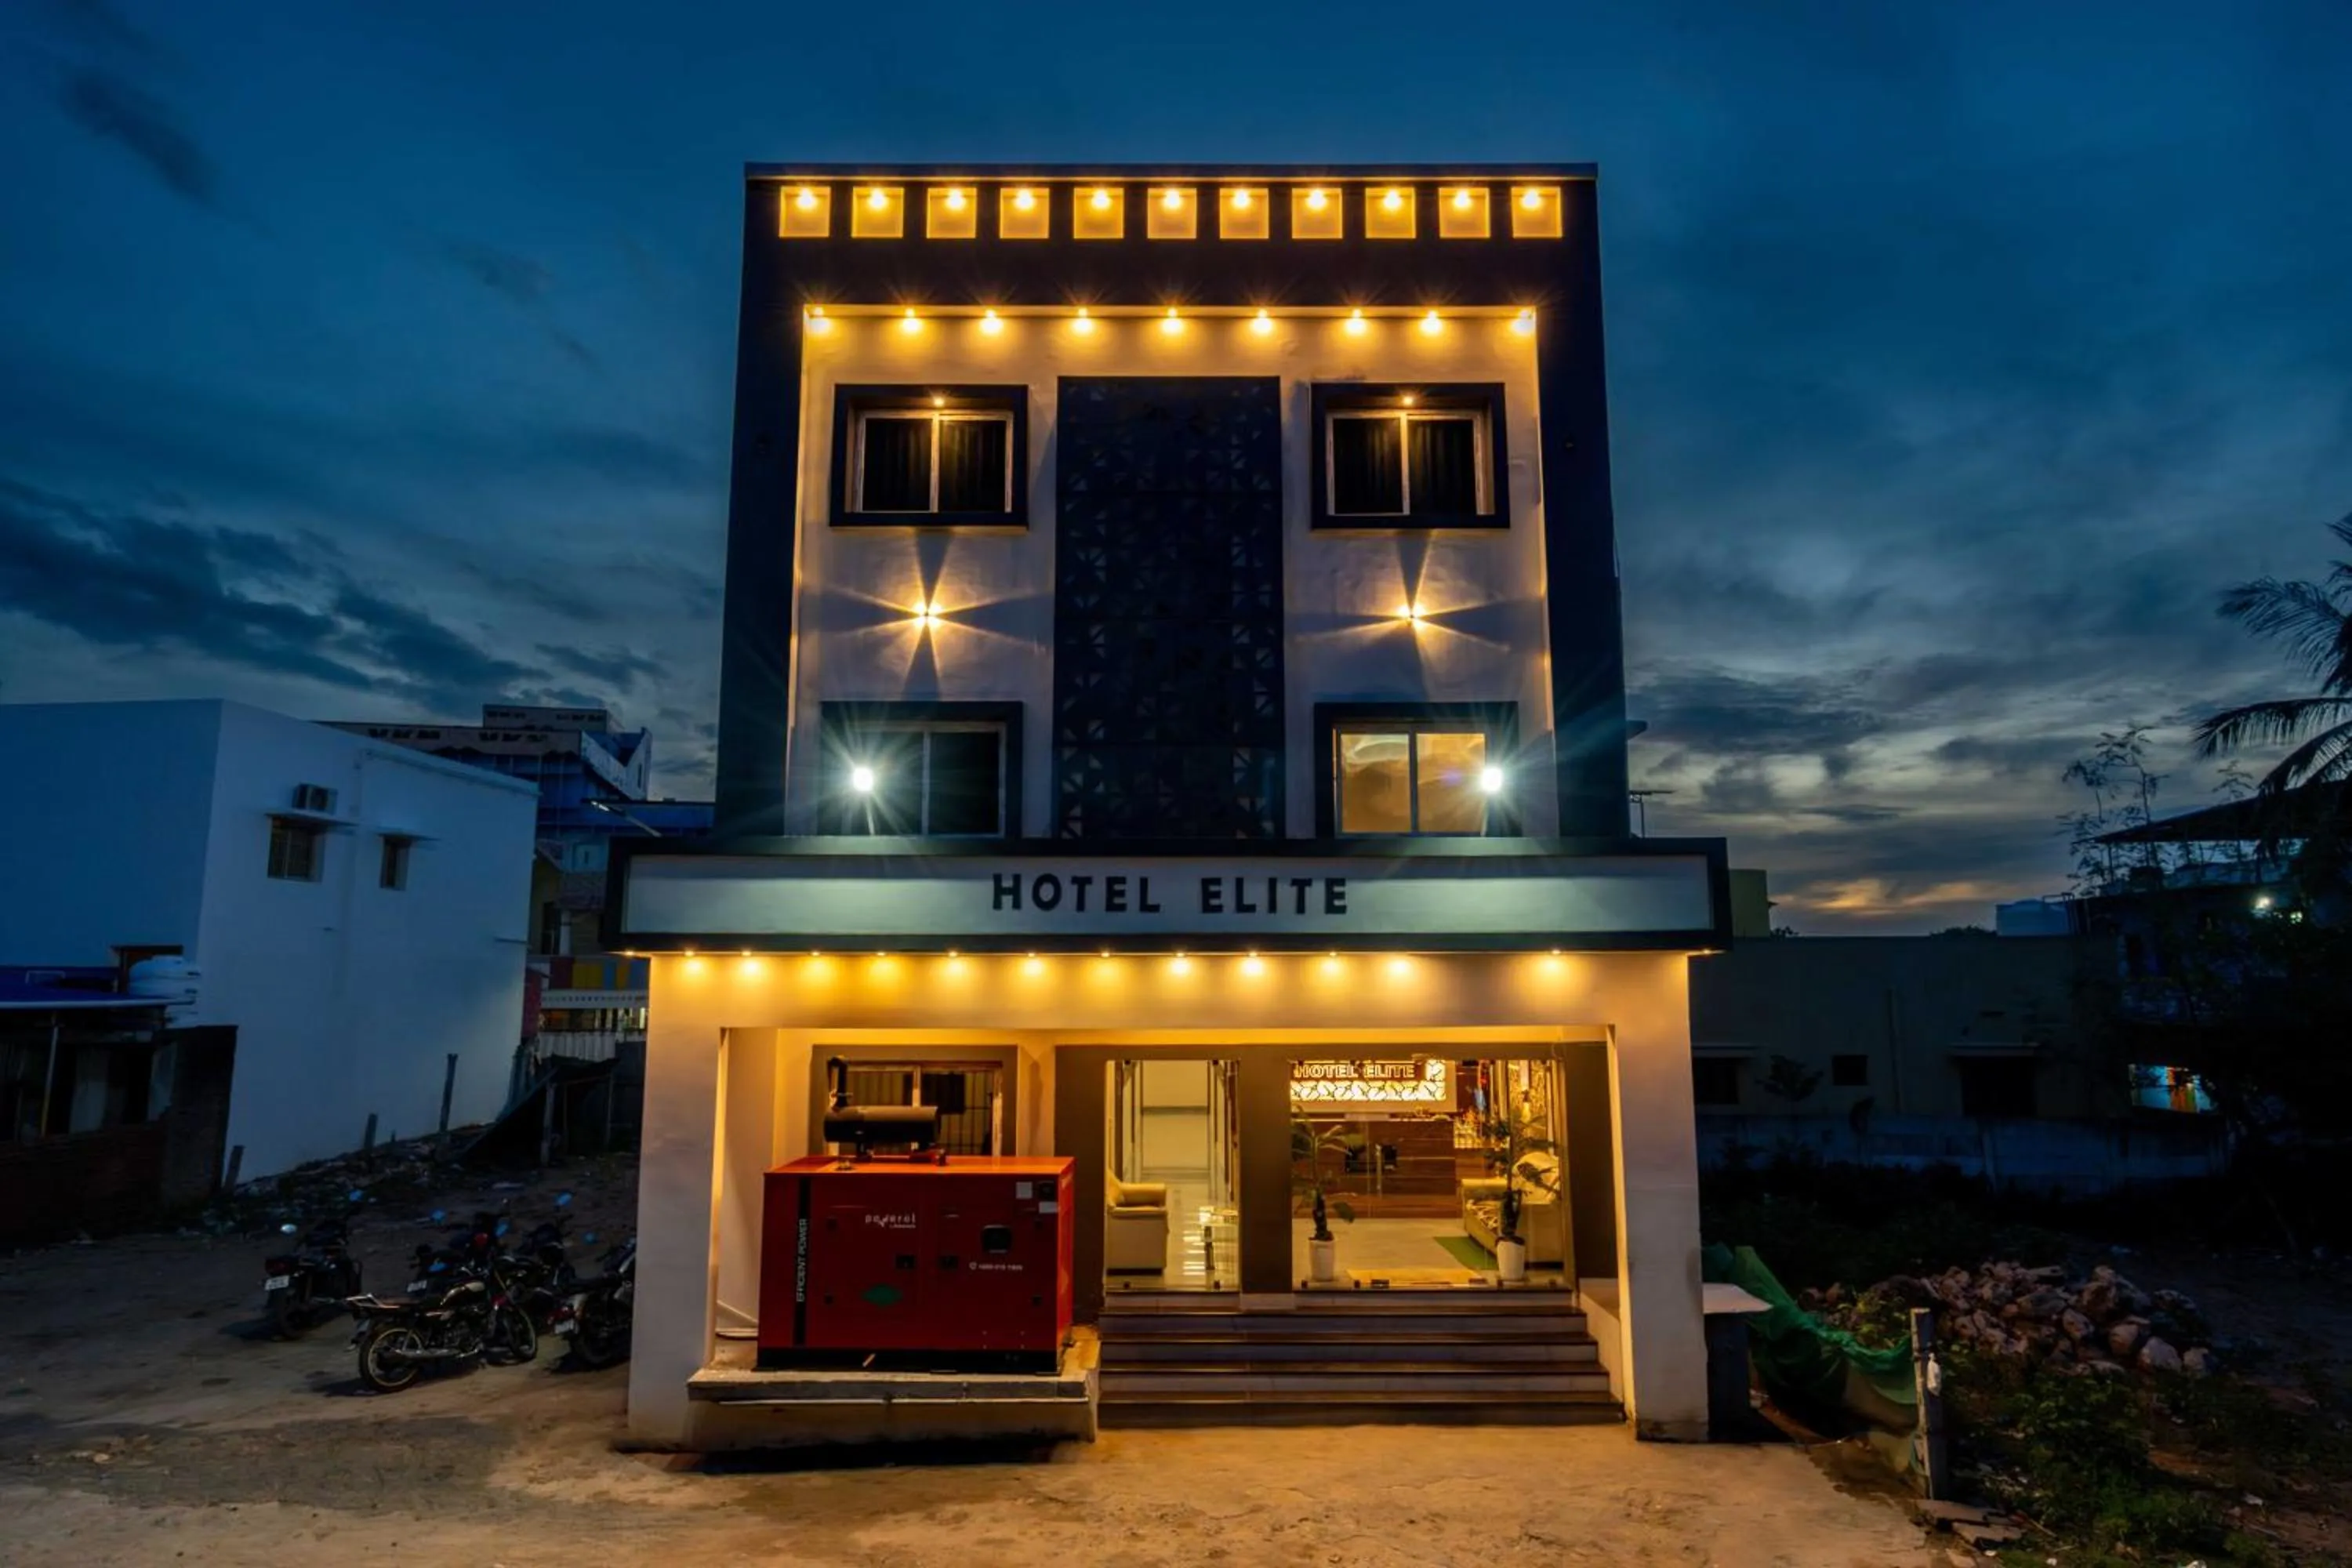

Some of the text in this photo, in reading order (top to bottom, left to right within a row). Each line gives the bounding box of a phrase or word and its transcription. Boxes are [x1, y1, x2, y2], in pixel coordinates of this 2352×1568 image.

[993, 873, 1347, 914] HOTEL ELITE
[1294, 1064, 1415, 1078] HOTEL ELITE
[797, 1218, 808, 1255] POWER
